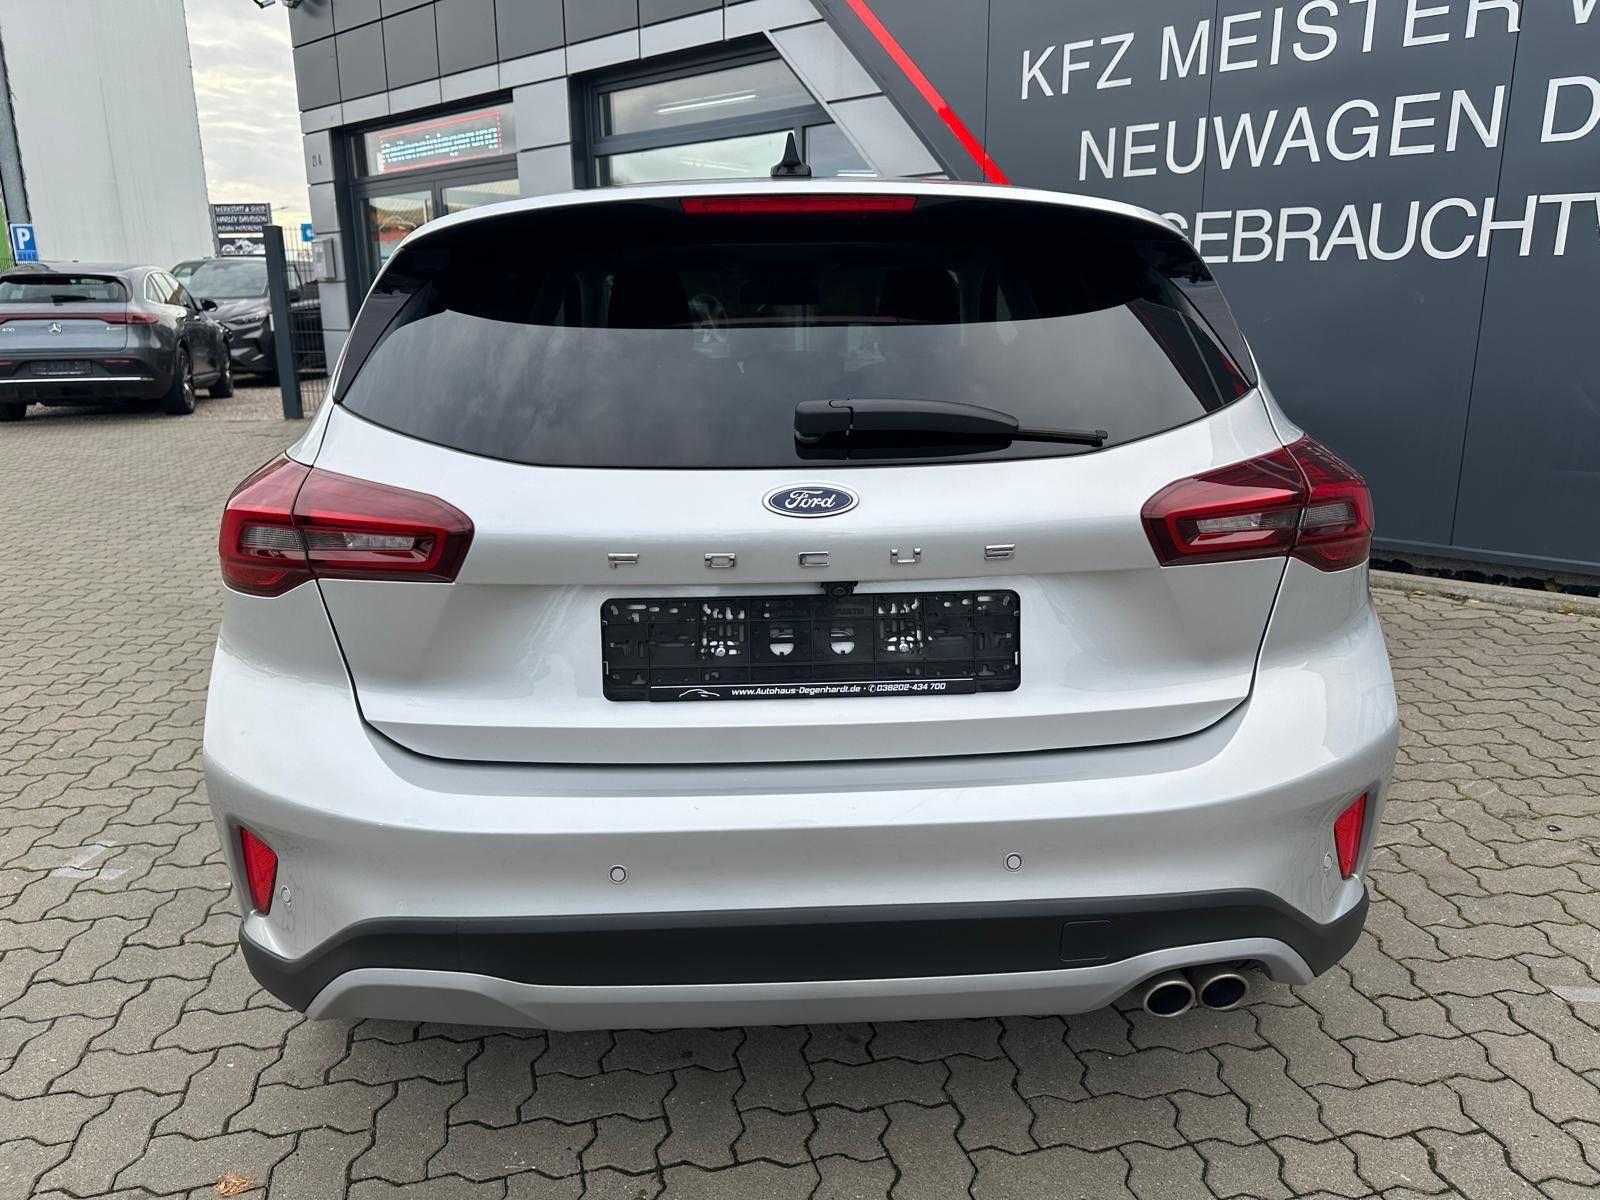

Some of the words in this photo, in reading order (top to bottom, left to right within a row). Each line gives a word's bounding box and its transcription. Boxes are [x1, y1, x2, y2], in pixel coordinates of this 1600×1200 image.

[1021, 33, 1135, 99] KFZ
[1160, 0, 1520, 81] MEISTER
[1078, 85, 1506, 181] NEUWAGEN
[16, 227, 30, 250] P
[1160, 193, 1600, 264] EBRAUCHT
[784, 490, 836, 509] Ford
[608, 543, 1016, 569] FOCUS
[731, 685, 861, 696] www.Autohaus-Degenhardt.de
[876, 683, 928, 692] 038202-434
[930, 682, 947, 691] 700
